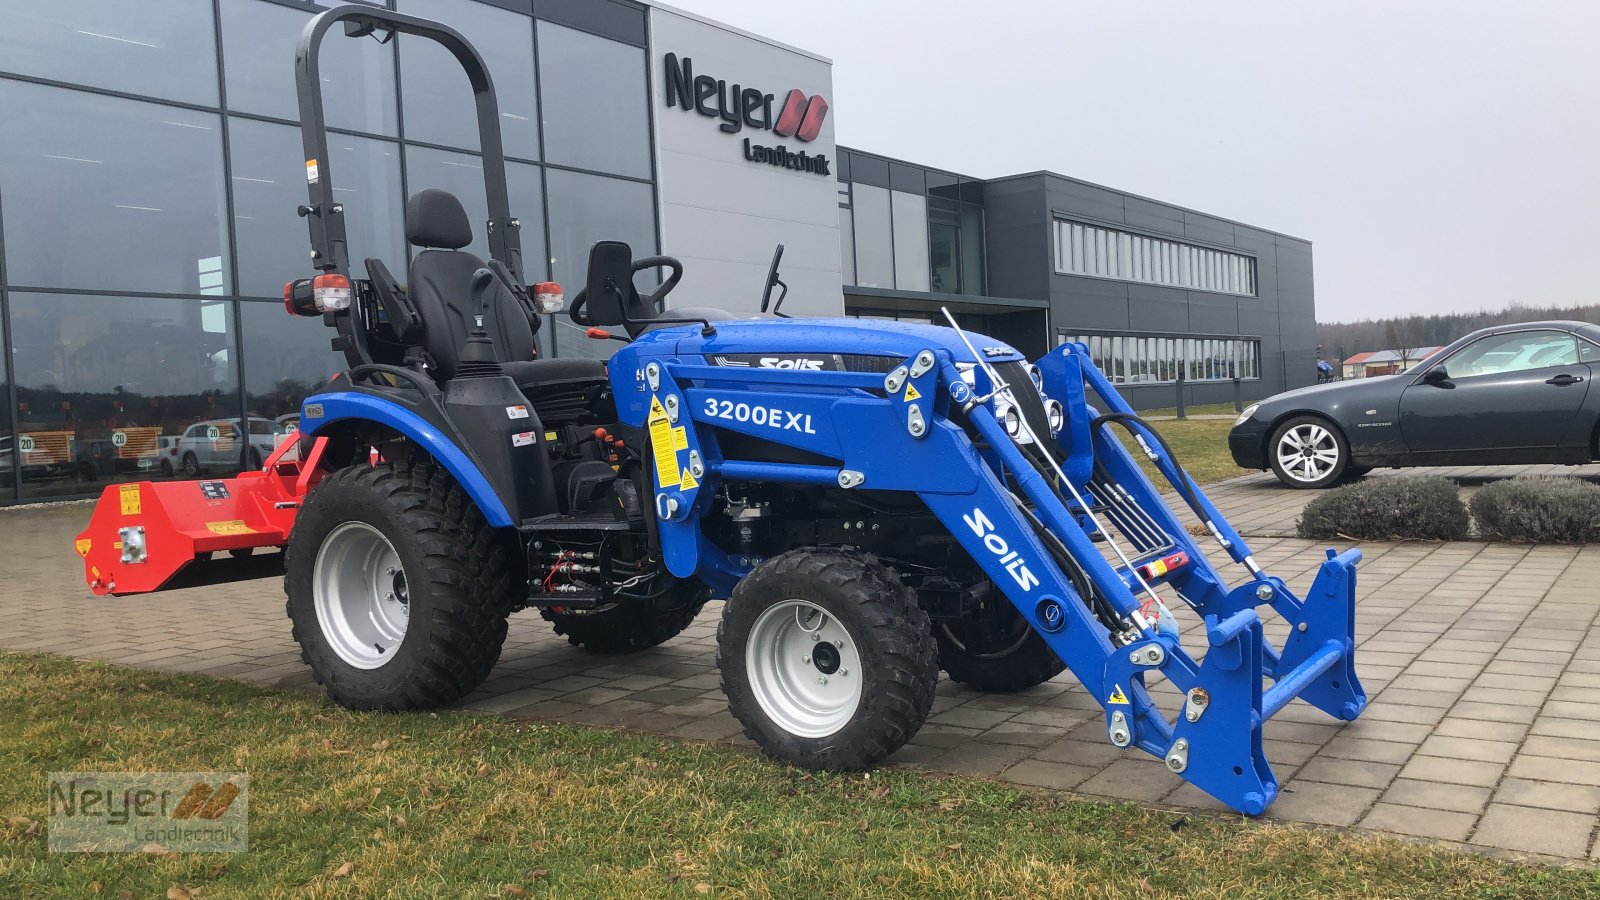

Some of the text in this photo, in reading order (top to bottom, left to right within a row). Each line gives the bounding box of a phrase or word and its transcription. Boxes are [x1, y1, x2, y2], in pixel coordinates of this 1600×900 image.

[664, 52, 775, 134] Neyer
[743, 137, 831, 176] Landtechnik
[704, 397, 817, 435] 3200EXL
[21, 439, 32, 449] 20
[115, 434, 125, 444] 20
[209, 429, 218, 438] 20
